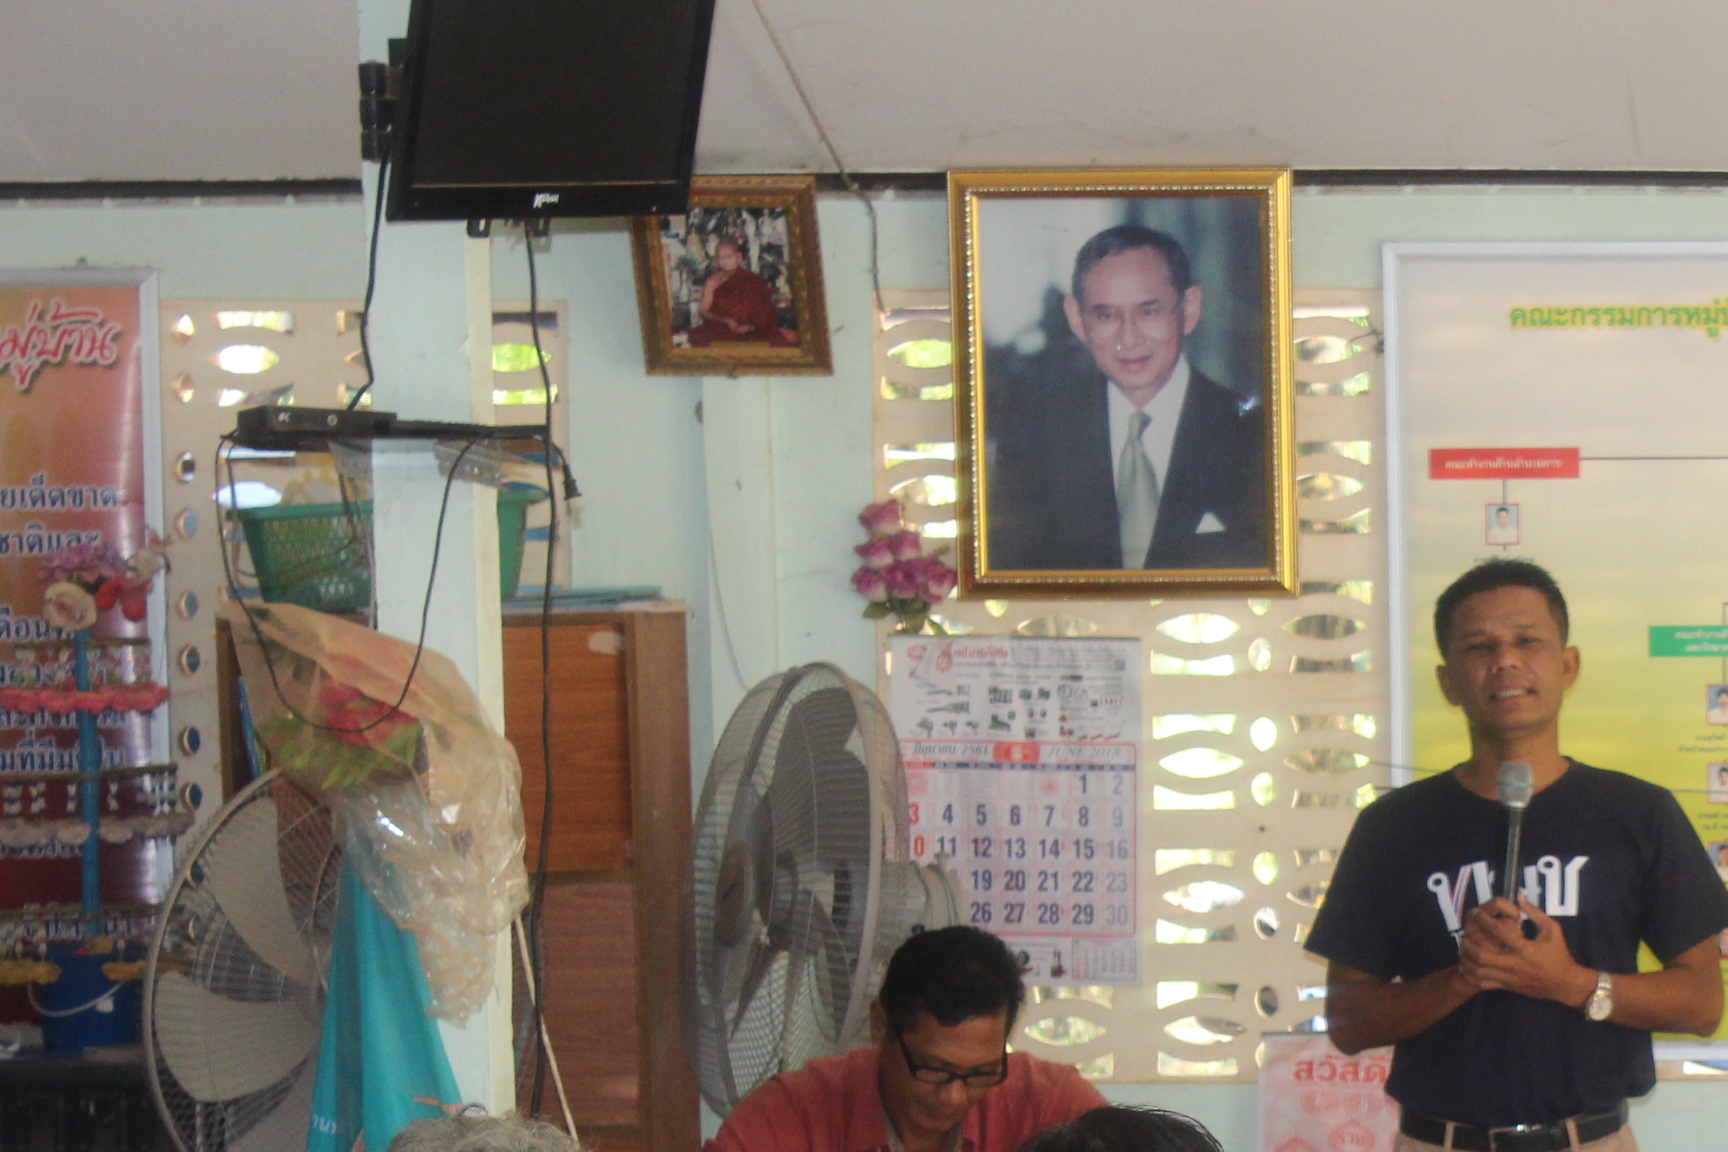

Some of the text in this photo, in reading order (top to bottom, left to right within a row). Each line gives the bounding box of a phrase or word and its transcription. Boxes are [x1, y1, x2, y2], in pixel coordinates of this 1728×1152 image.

[1079, 774, 1123, 795] 1 2
[909, 802, 1123, 828] 3 4 5 6 7 8 9
[971, 837, 992, 858] 12
[1004, 837, 1026, 859] 13
[1039, 838, 1060, 859] 14
[1073, 838, 1094, 859] 15
[1107, 839, 1128, 860] 16
[971, 869, 1128, 894] 19 20 21 22 23
[970, 902, 1128, 926] 26 27 28 29 30
